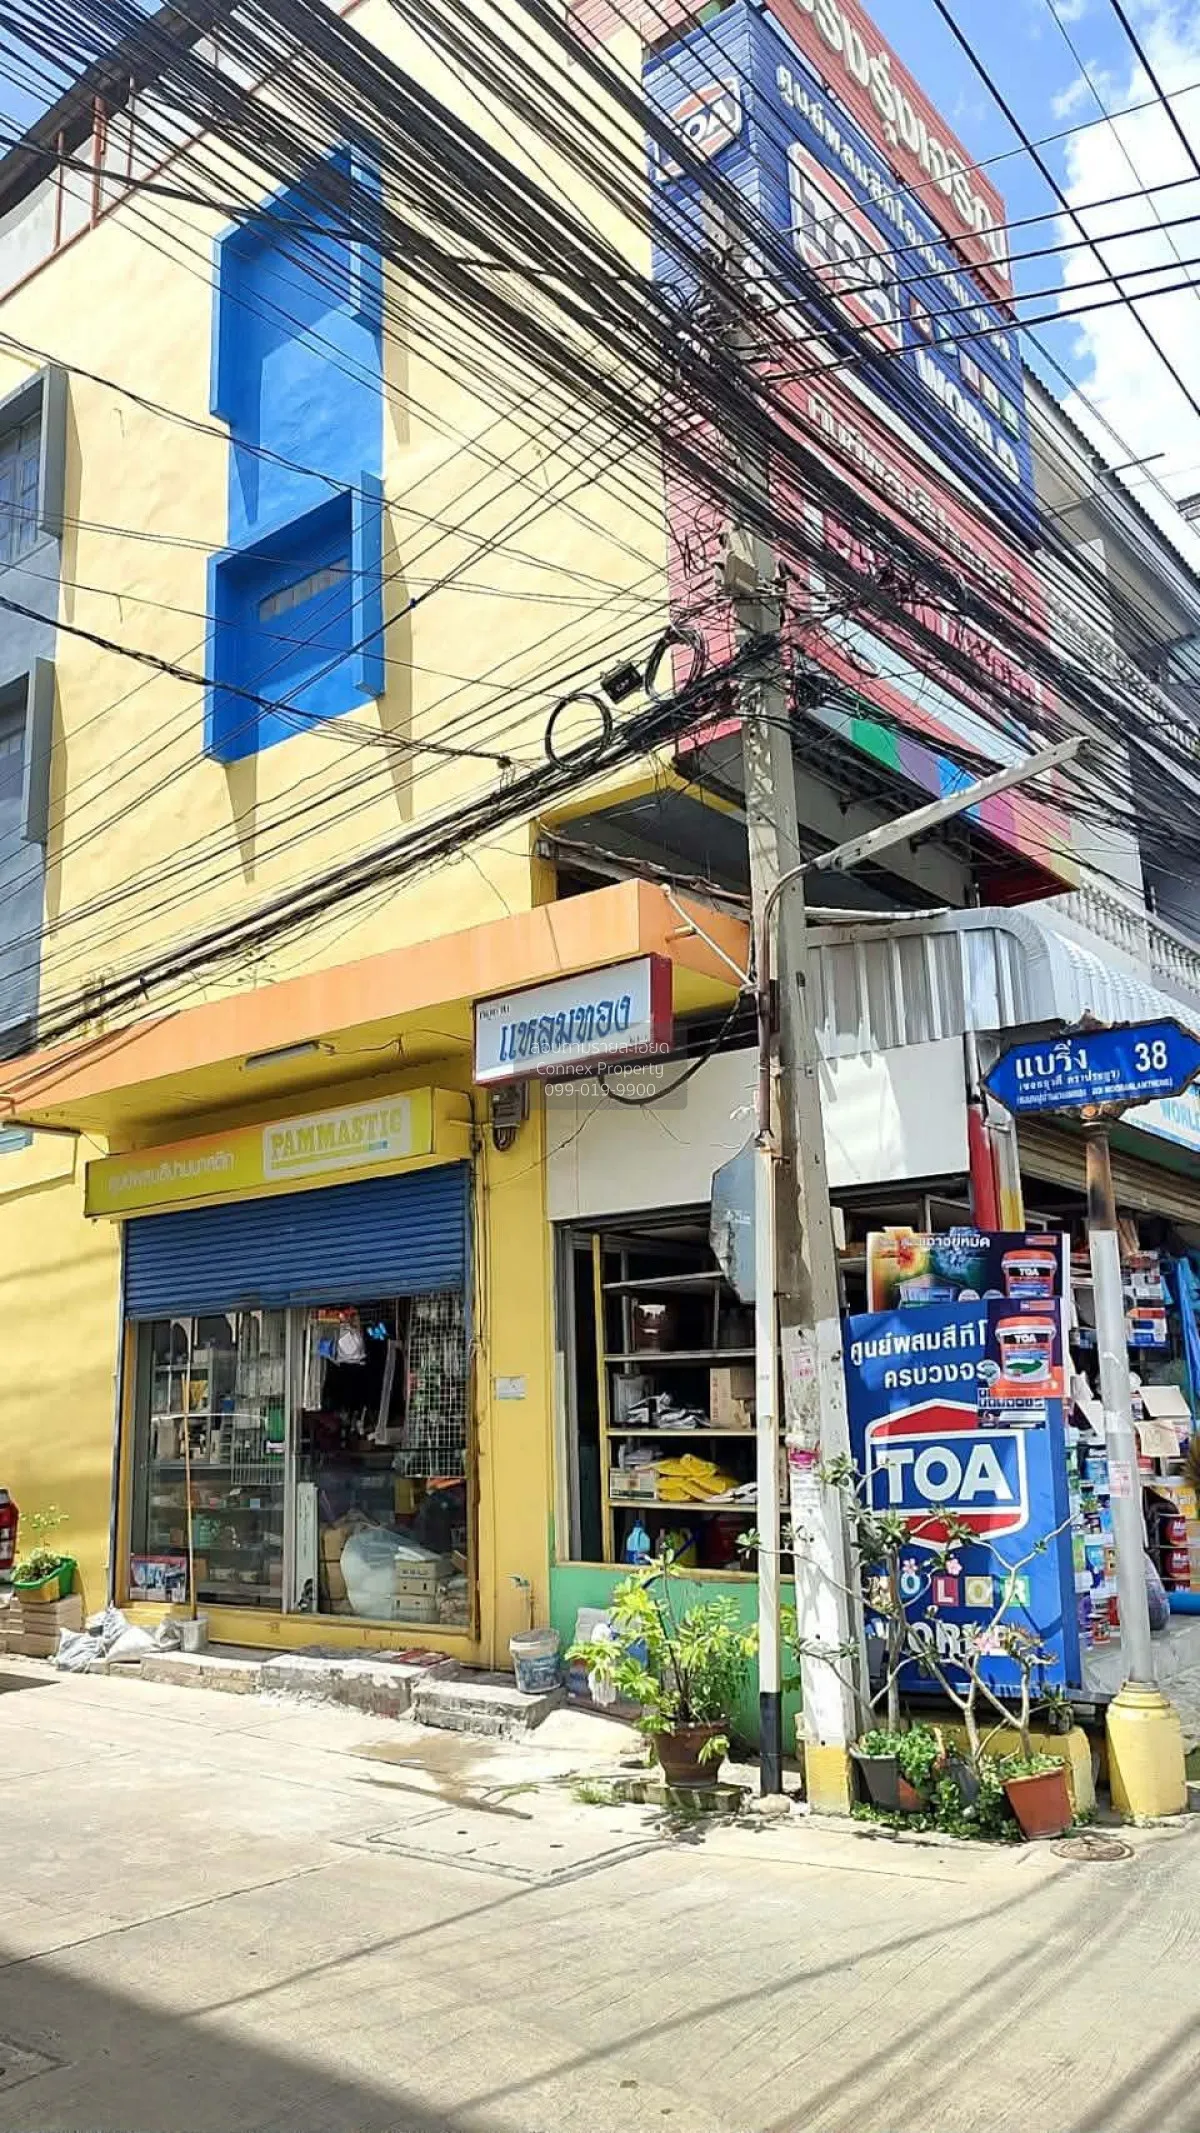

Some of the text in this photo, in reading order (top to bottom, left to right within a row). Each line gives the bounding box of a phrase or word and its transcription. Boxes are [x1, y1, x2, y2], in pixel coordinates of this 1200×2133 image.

[499, 994, 632, 1062] แหลมทอง
[1016, 1040, 1168, 1080] แบริ่ง 38
[271, 1107, 402, 1160] PAMMASTIC
[875, 1443, 1015, 1504] TOA
